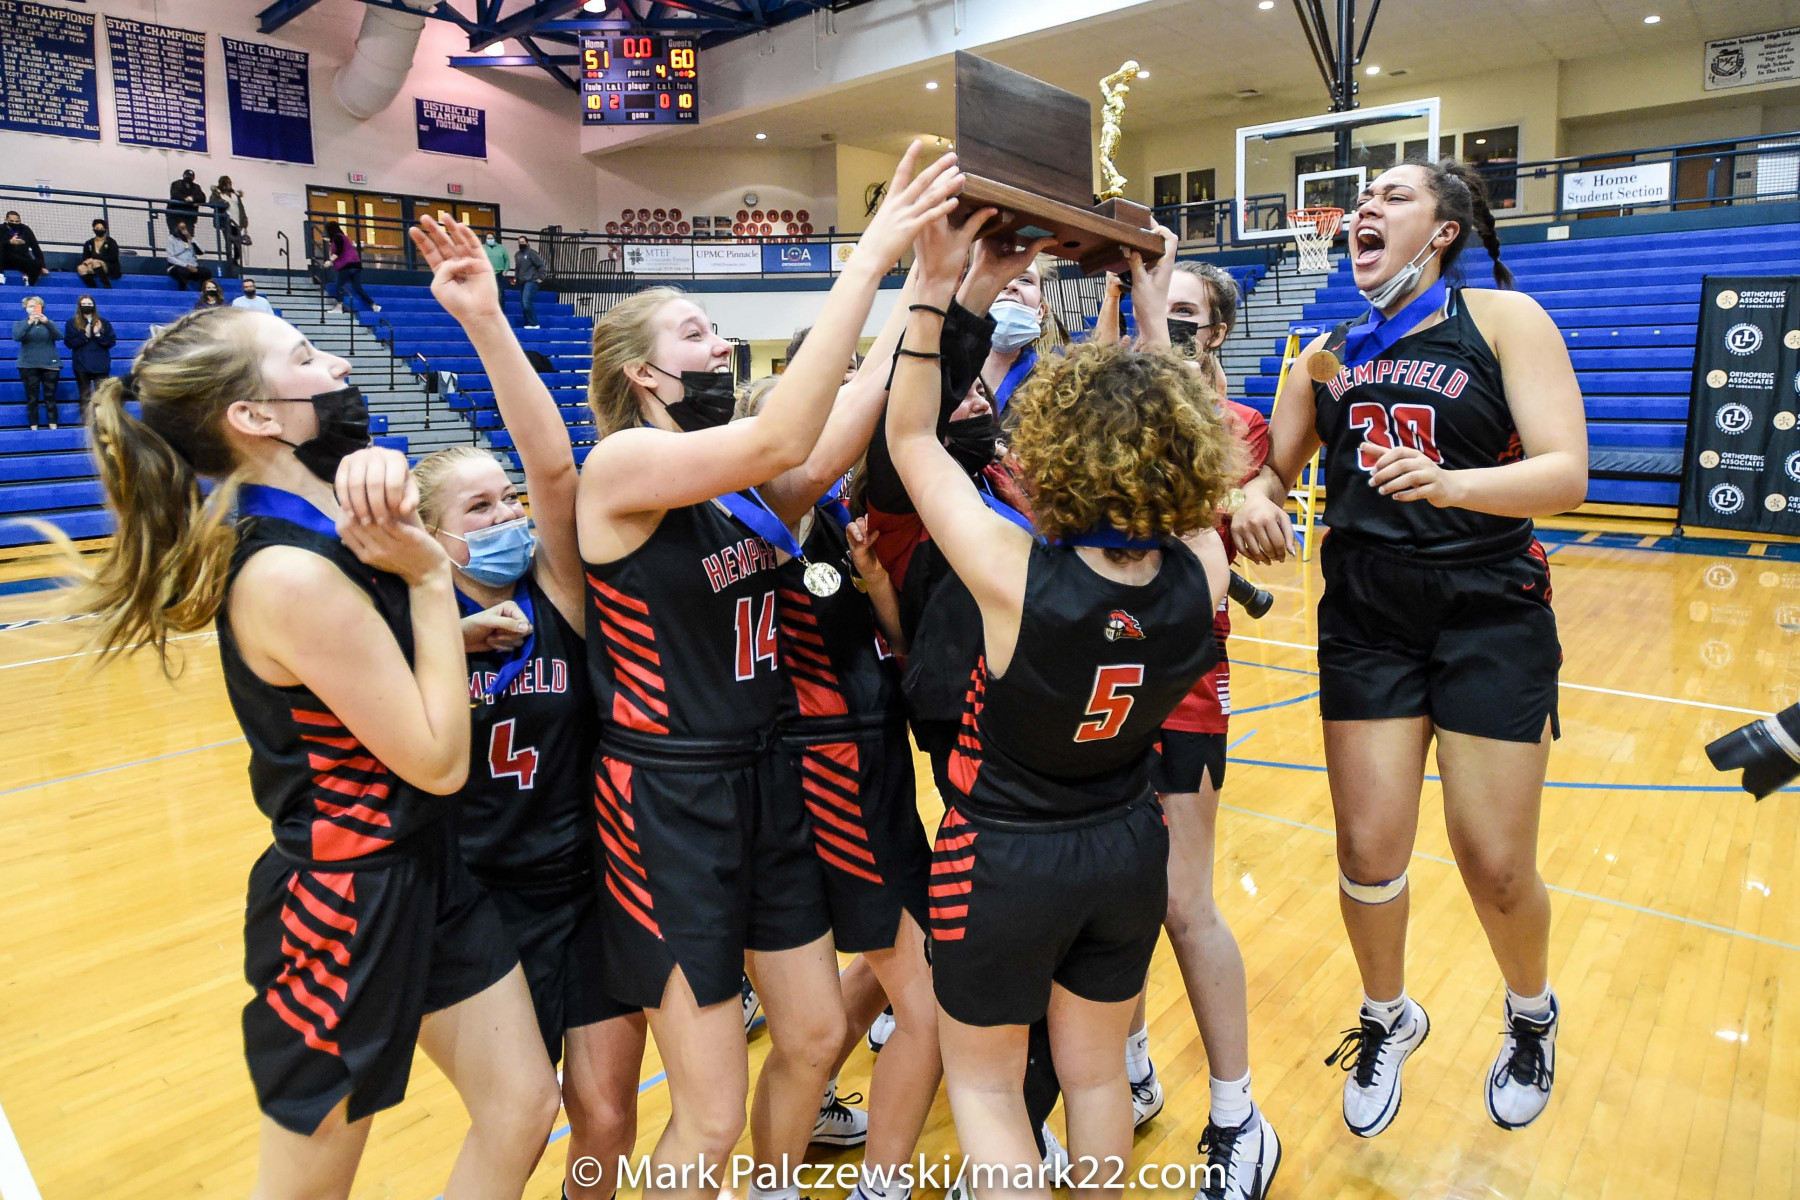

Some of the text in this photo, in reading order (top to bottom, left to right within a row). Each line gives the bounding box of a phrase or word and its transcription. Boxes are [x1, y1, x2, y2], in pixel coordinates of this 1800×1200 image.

[22, 4, 93, 25] CHAMPIONS
[106, 18, 204, 44] STATE CHAMPIONS
[226, 40, 254, 53] STATE
[258, 46, 305, 63] CHAMPIONS
[584, 40, 605, 48] Home
[668, 39, 692, 48] Guests
[585, 48, 694, 70] 51 60
[627, 69, 650, 78] period
[585, 83, 602, 91] fouls
[627, 82, 650, 91] player
[423, 101, 466, 115] DISTRICT
[587, 93, 692, 110] 10 2 0 10
[423, 109, 478, 125] CHAMPIONS
[631, 112, 649, 120] game
[436, 119, 468, 132] FOOTBALL
[1593, 174, 1638, 187] Home
[1567, 184, 1663, 204] Student Section
[696, 249, 758, 258] UPMC Pinnacle
[1350, 402, 1444, 471] 30
[1720, 459, 1764, 467] ASSOCIATES
[1721, 452, 1765, 460] ORTHOPEDIC
[735, 590, 778, 682] 14
[1073, 664, 1145, 743] 5
[487, 717, 539, 790] 4
